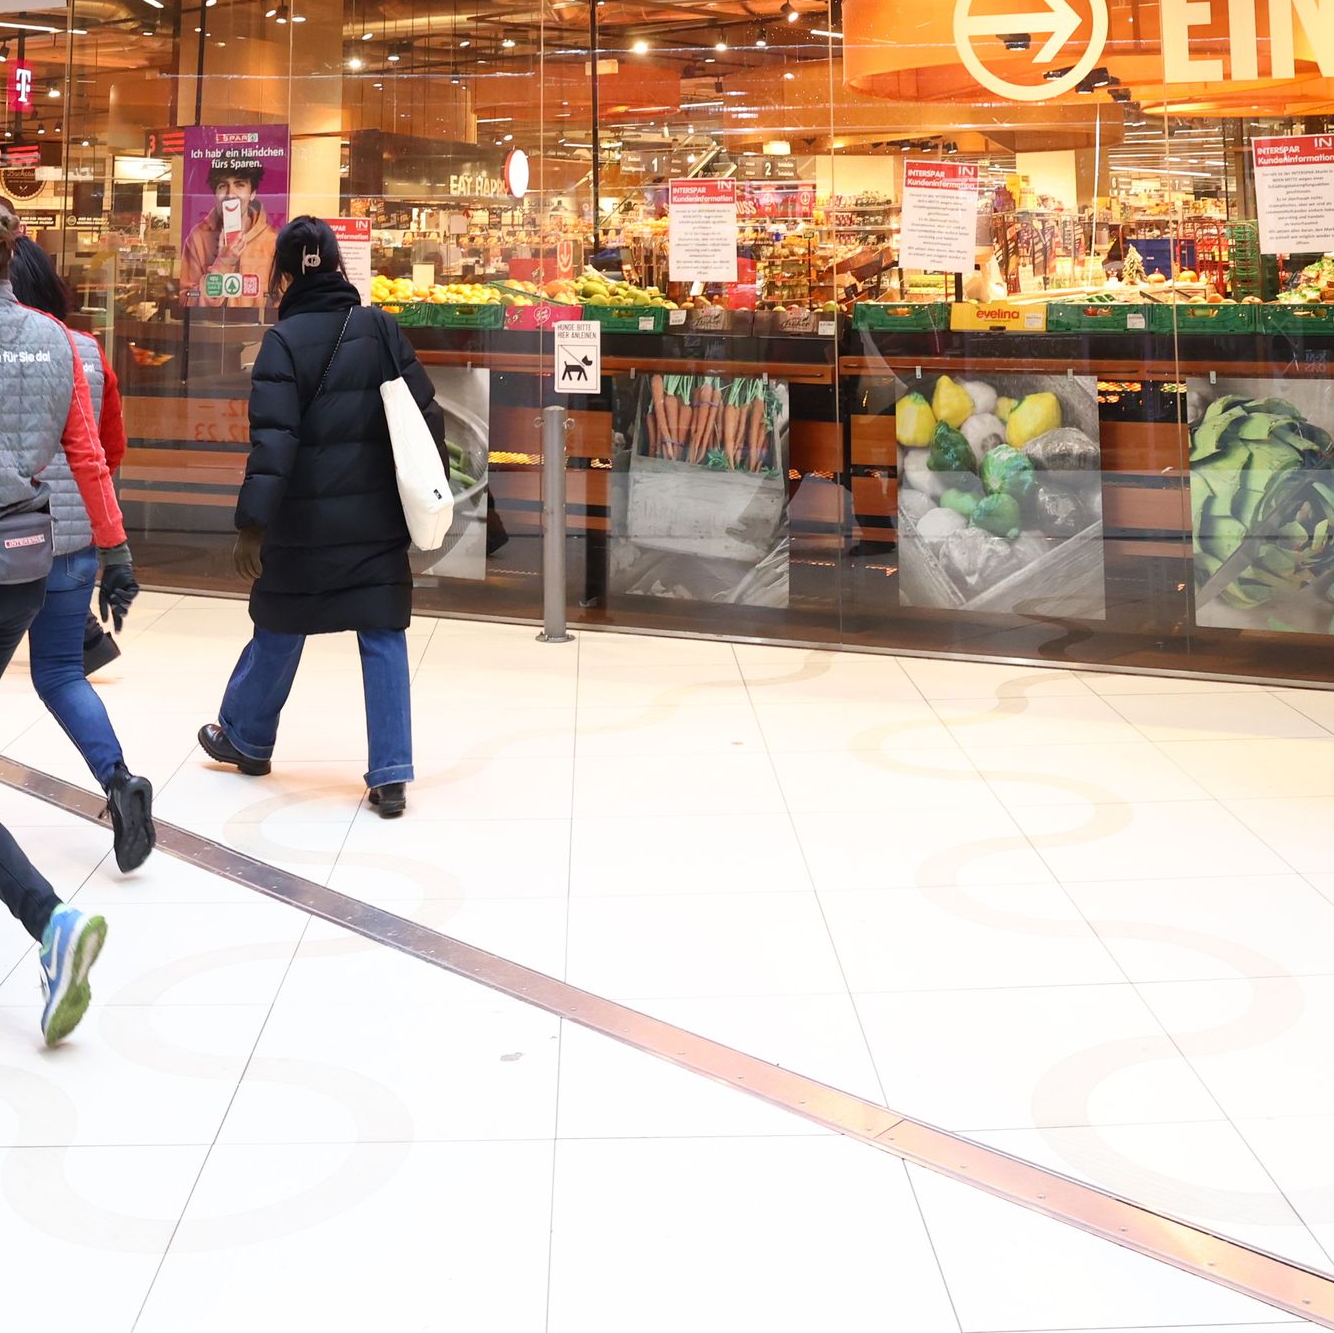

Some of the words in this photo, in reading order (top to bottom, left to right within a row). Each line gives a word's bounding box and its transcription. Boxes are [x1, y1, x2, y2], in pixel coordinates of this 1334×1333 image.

[223, 134, 248, 142] SPAR
[1314, 137, 1333, 148] IN
[191, 149, 203, 159] Ich
[225, 148, 239, 157] ein
[241, 146, 284, 157] Händchen
[1257, 145, 1301, 155] INTERSPAR
[211, 159, 228, 169] fürs
[230, 159, 263, 170] Sparen.
[1257, 154, 1334, 165] Kundeninformation
[907, 169, 946, 178] INTERSPAR
[958, 166, 975, 176] IN
[717, 181, 732, 189] IN
[907, 178, 976, 189] Kundeninformation
[672, 186, 707, 194] INTERSPAR
[672, 195, 733, 203] Kundeninformation
[976, 308, 1020, 319] evelina
[3, 350, 18, 363] für
[19, 350, 35, 363] Sie
